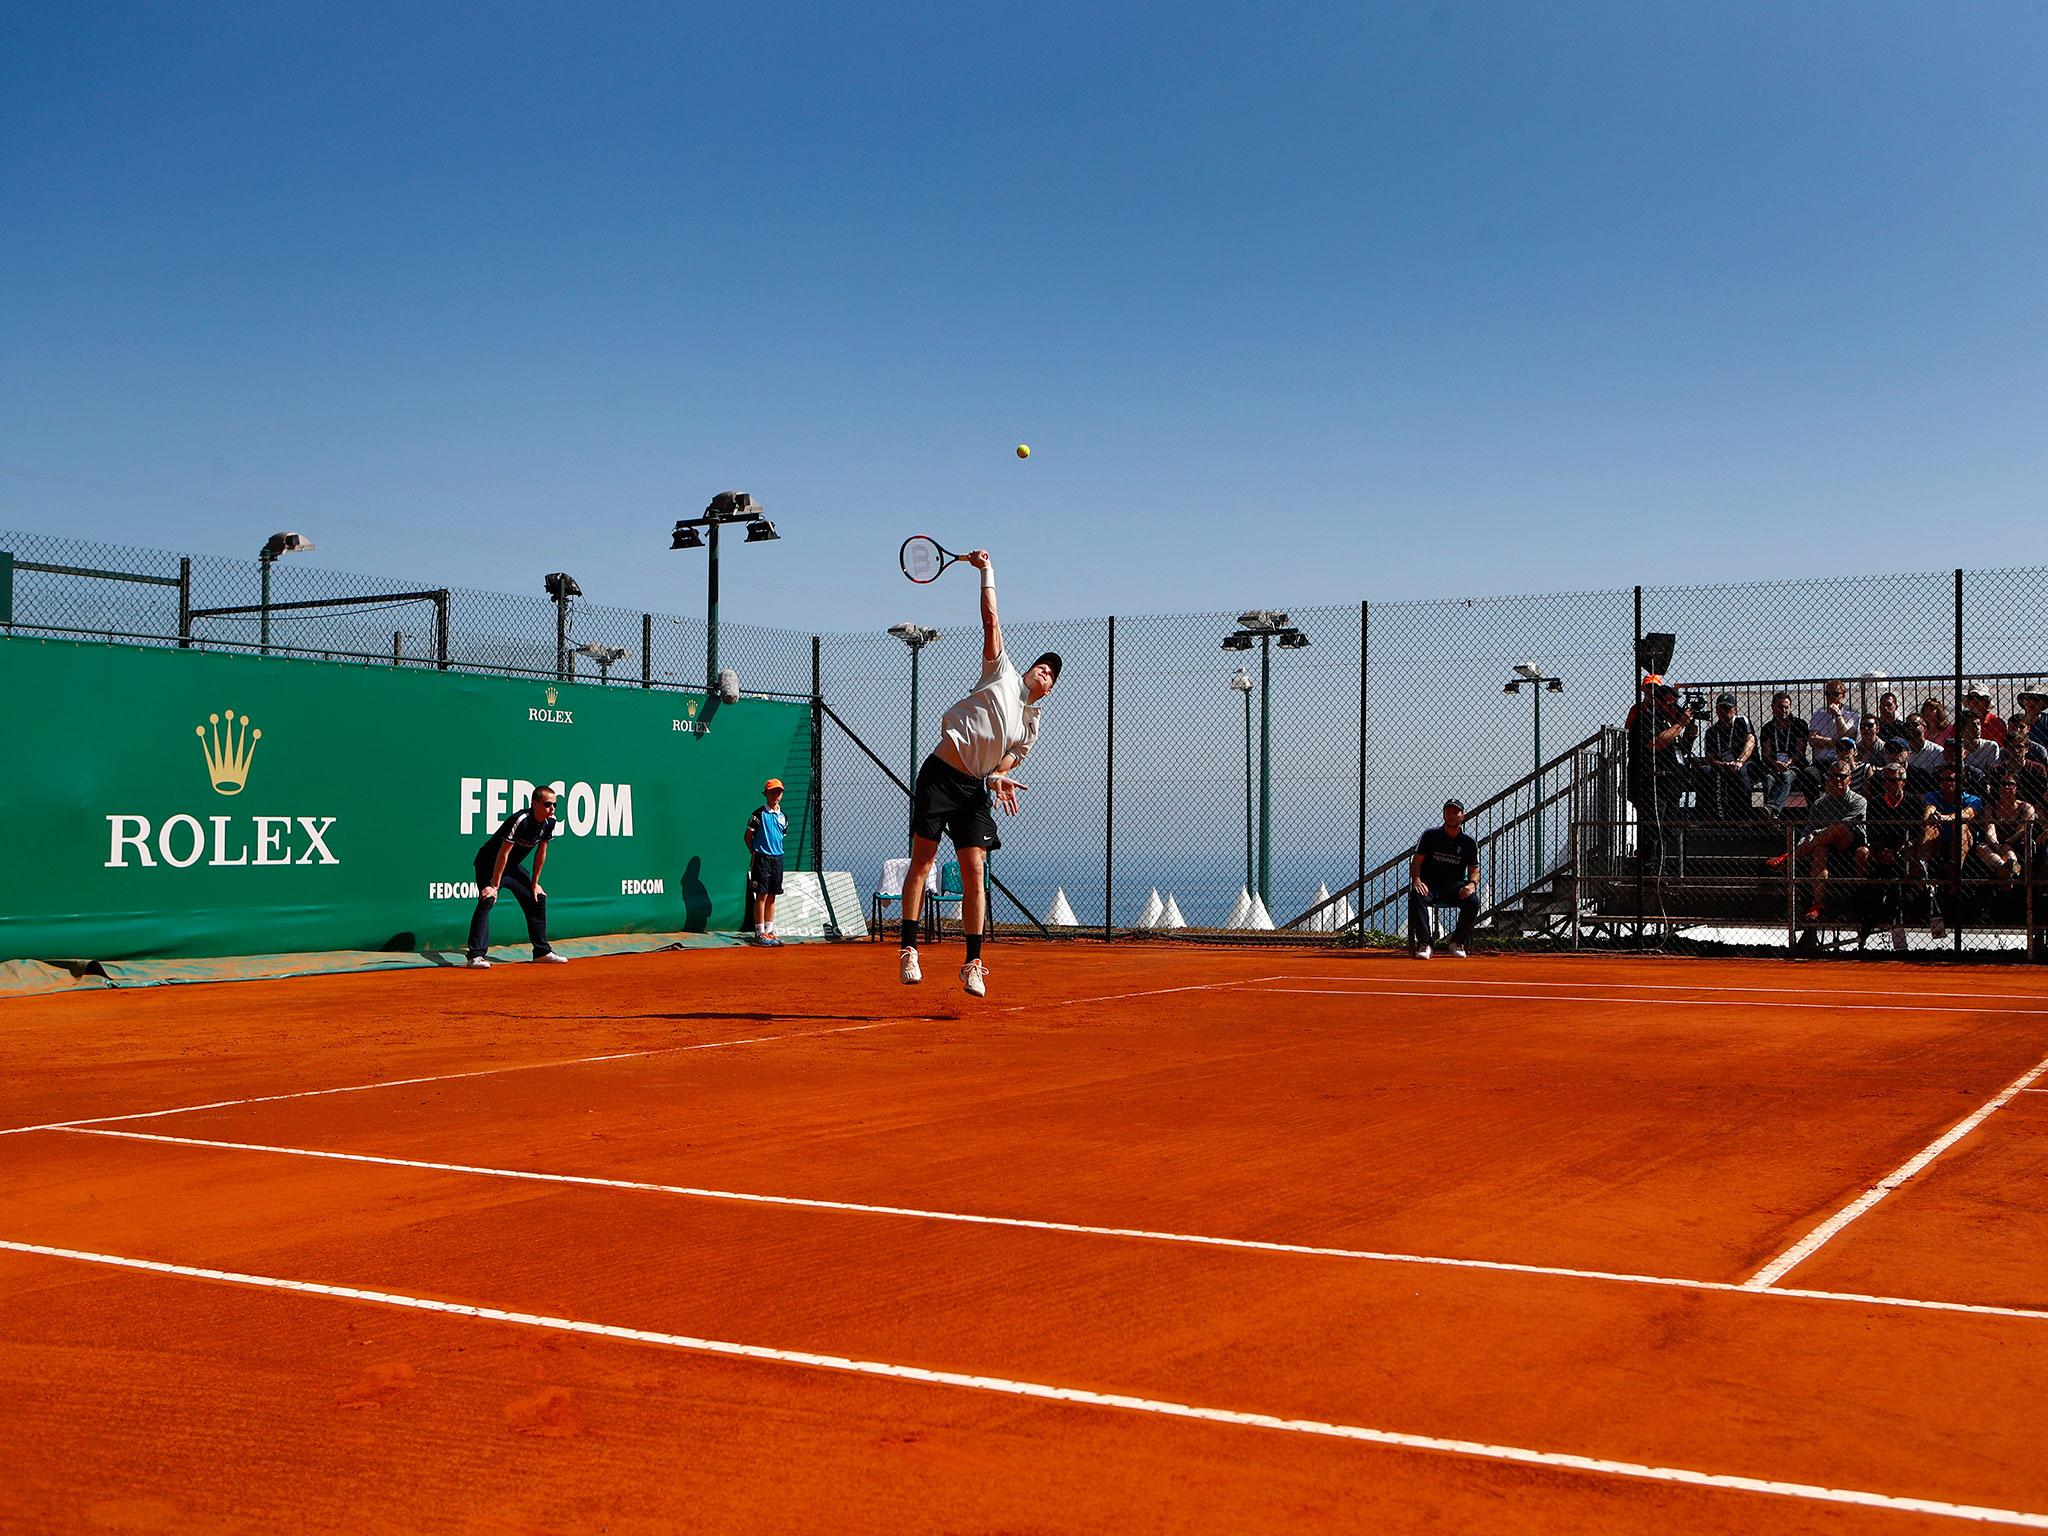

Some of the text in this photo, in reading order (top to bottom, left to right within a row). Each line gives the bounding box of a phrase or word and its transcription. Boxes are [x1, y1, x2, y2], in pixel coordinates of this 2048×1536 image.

[528, 708, 573, 724] ROLEX
[672, 719, 710, 734] ROLEX
[104, 814, 340, 868] ROLEX
[429, 882, 480, 899] FEDCOM
[621, 879, 664, 895] FEDCOM
